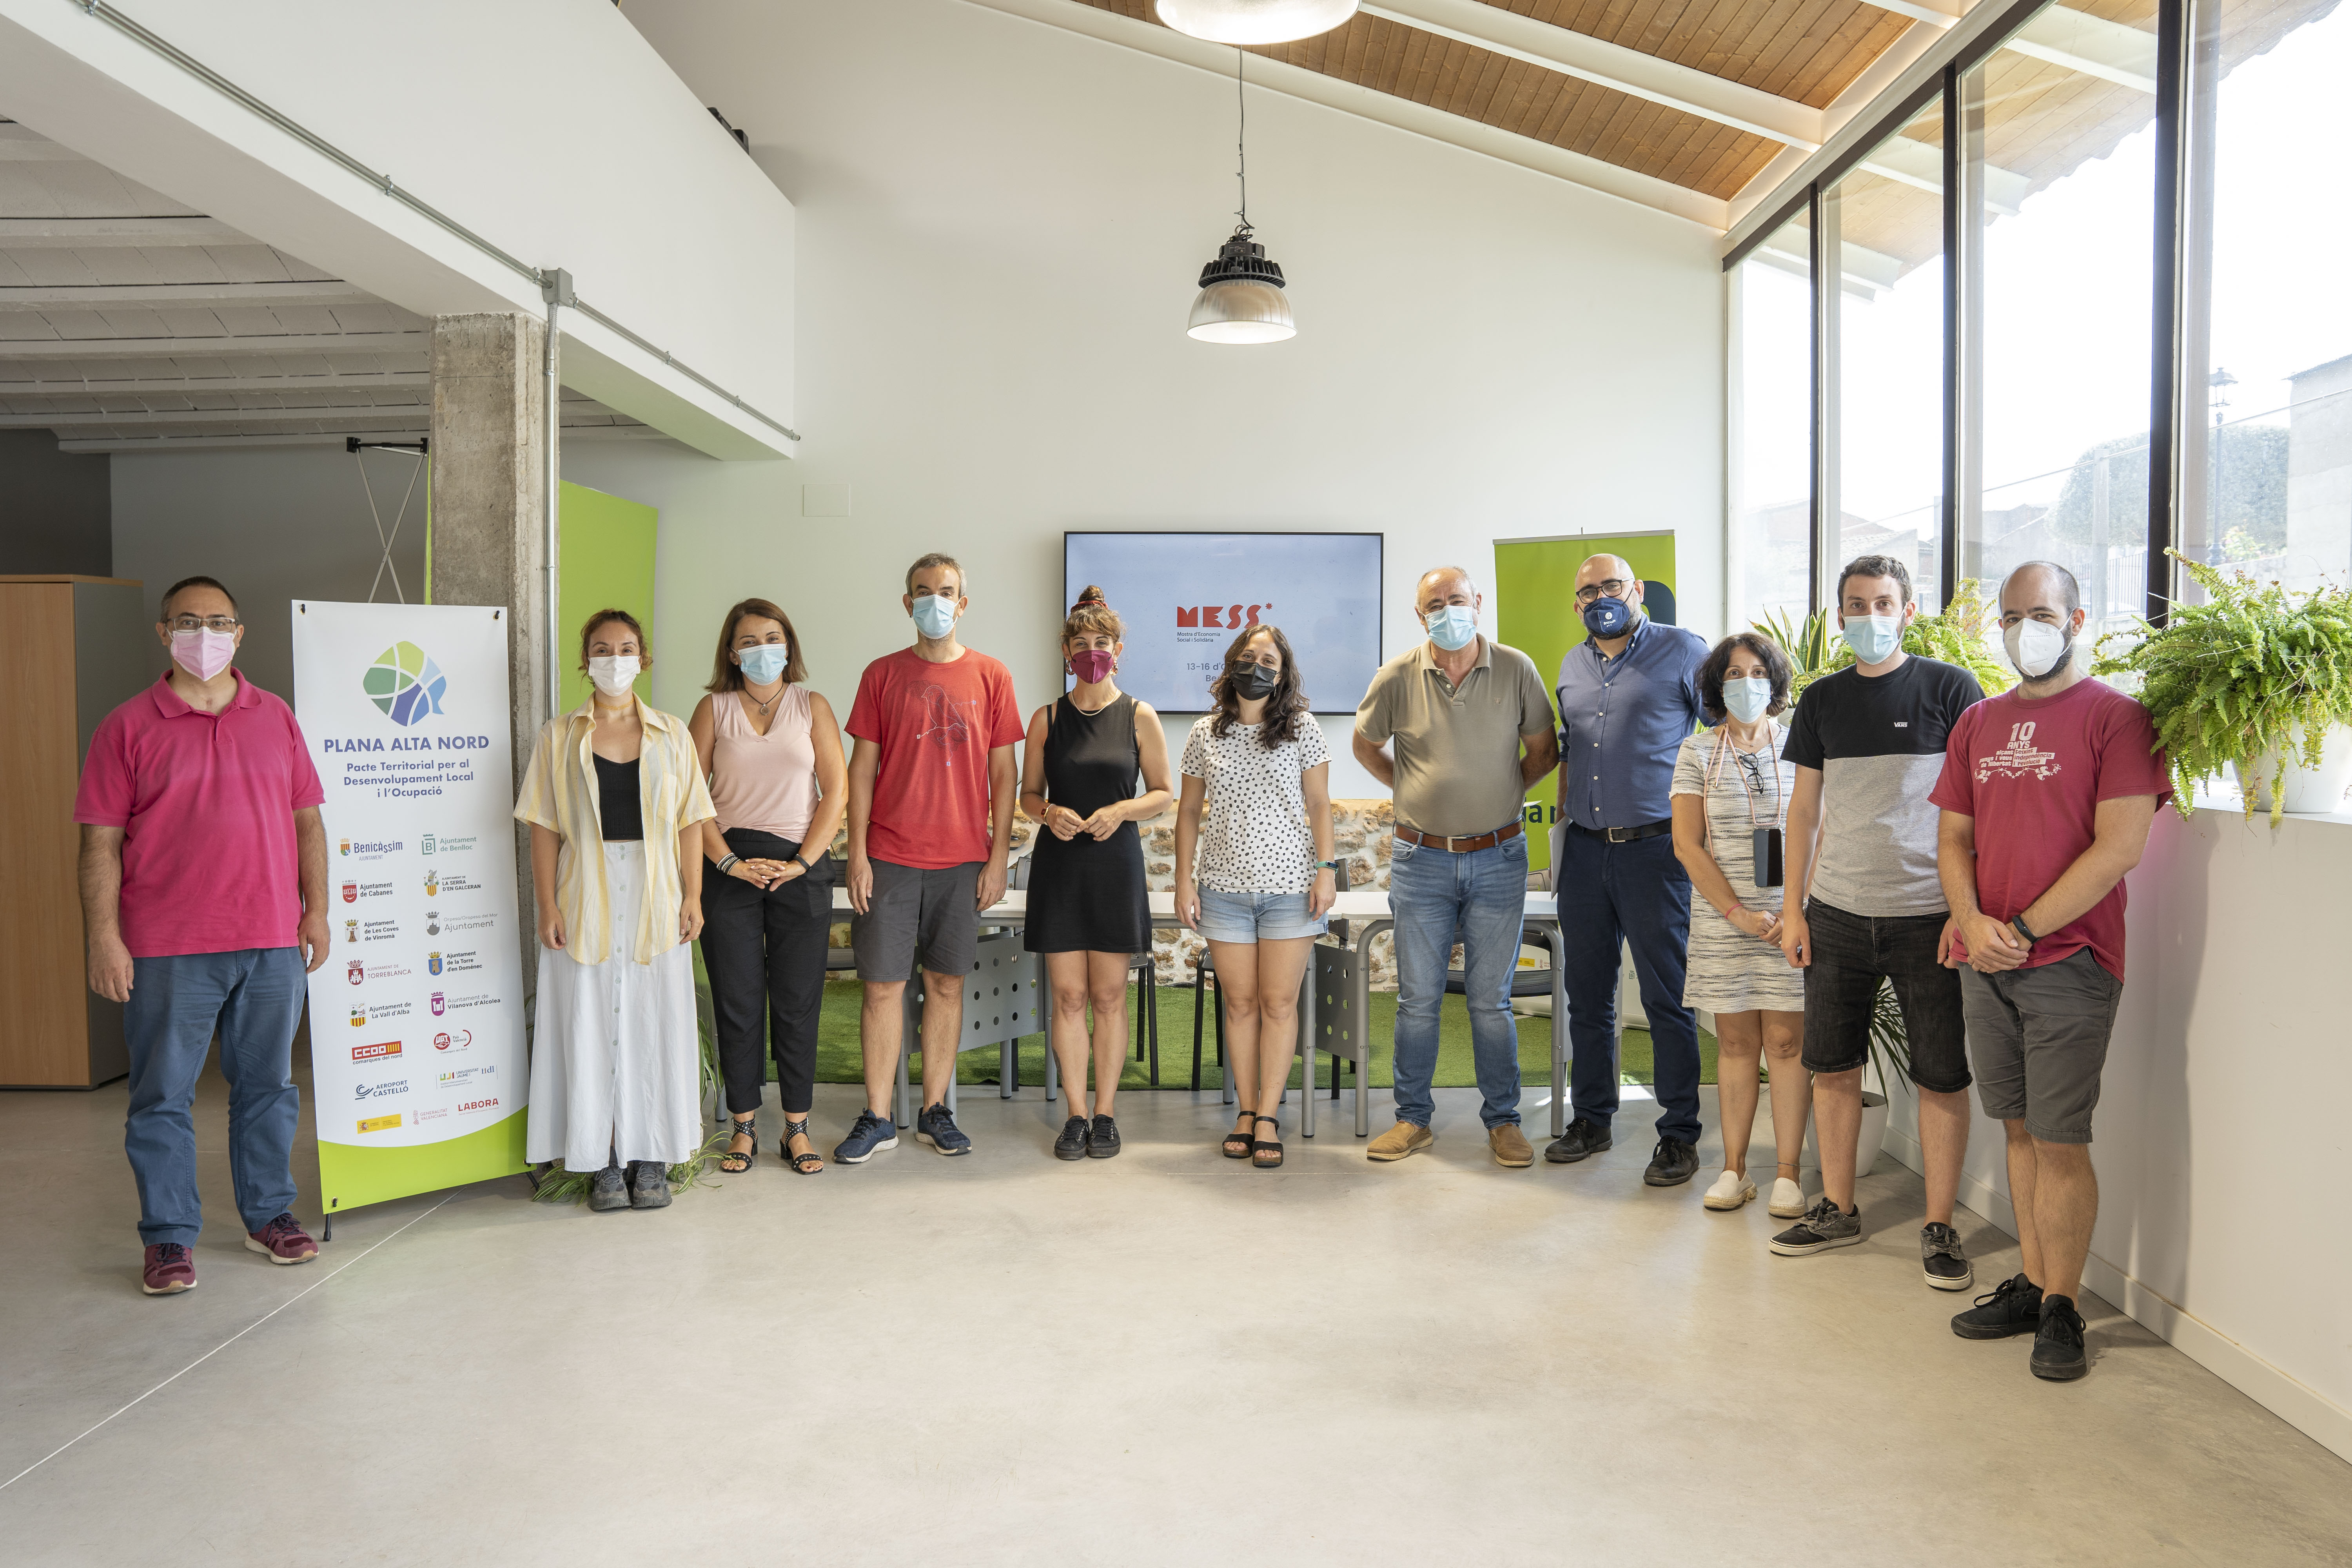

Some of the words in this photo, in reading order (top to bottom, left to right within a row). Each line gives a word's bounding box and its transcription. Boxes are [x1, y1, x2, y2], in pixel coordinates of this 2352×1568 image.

[2010, 721, 2036, 741] 10
[324, 738, 385, 753] PLANA
[391, 737, 432, 751] ALTA
[438, 736, 489, 750] NORD
[2007, 740, 2031, 749] ANYS
[347, 763, 376, 772] Pacte
[380, 760, 434, 771] Territorial
[438, 762, 456, 771] per
[459, 759, 469, 768] al
[344, 774, 443, 786] Desenvolupament
[446, 771, 474, 782] Local
[377, 788, 380, 797] i
[384, 786, 442, 799] l'Ocupació
[440, 837, 477, 845] Ajuntament
[360, 882, 392, 891] Ajuntament
[364, 920, 395, 928] Ajuntament
[445, 920, 494, 933] Ajuntament
[446, 951, 476, 959] Ajuntament
[367, 969, 412, 979] TORREBLANCA
[447, 995, 480, 1004] Ajuntament
[369, 1003, 403, 1013] Ajuntament
[354, 1045, 387, 1058] CCOO
[376, 1080, 407, 1089] AEROPORT
[373, 1085, 408, 1097] CASTELLÓ
[458, 1098, 499, 1112] LABORA
[420, 1108, 448, 1116] GENERALITAT
